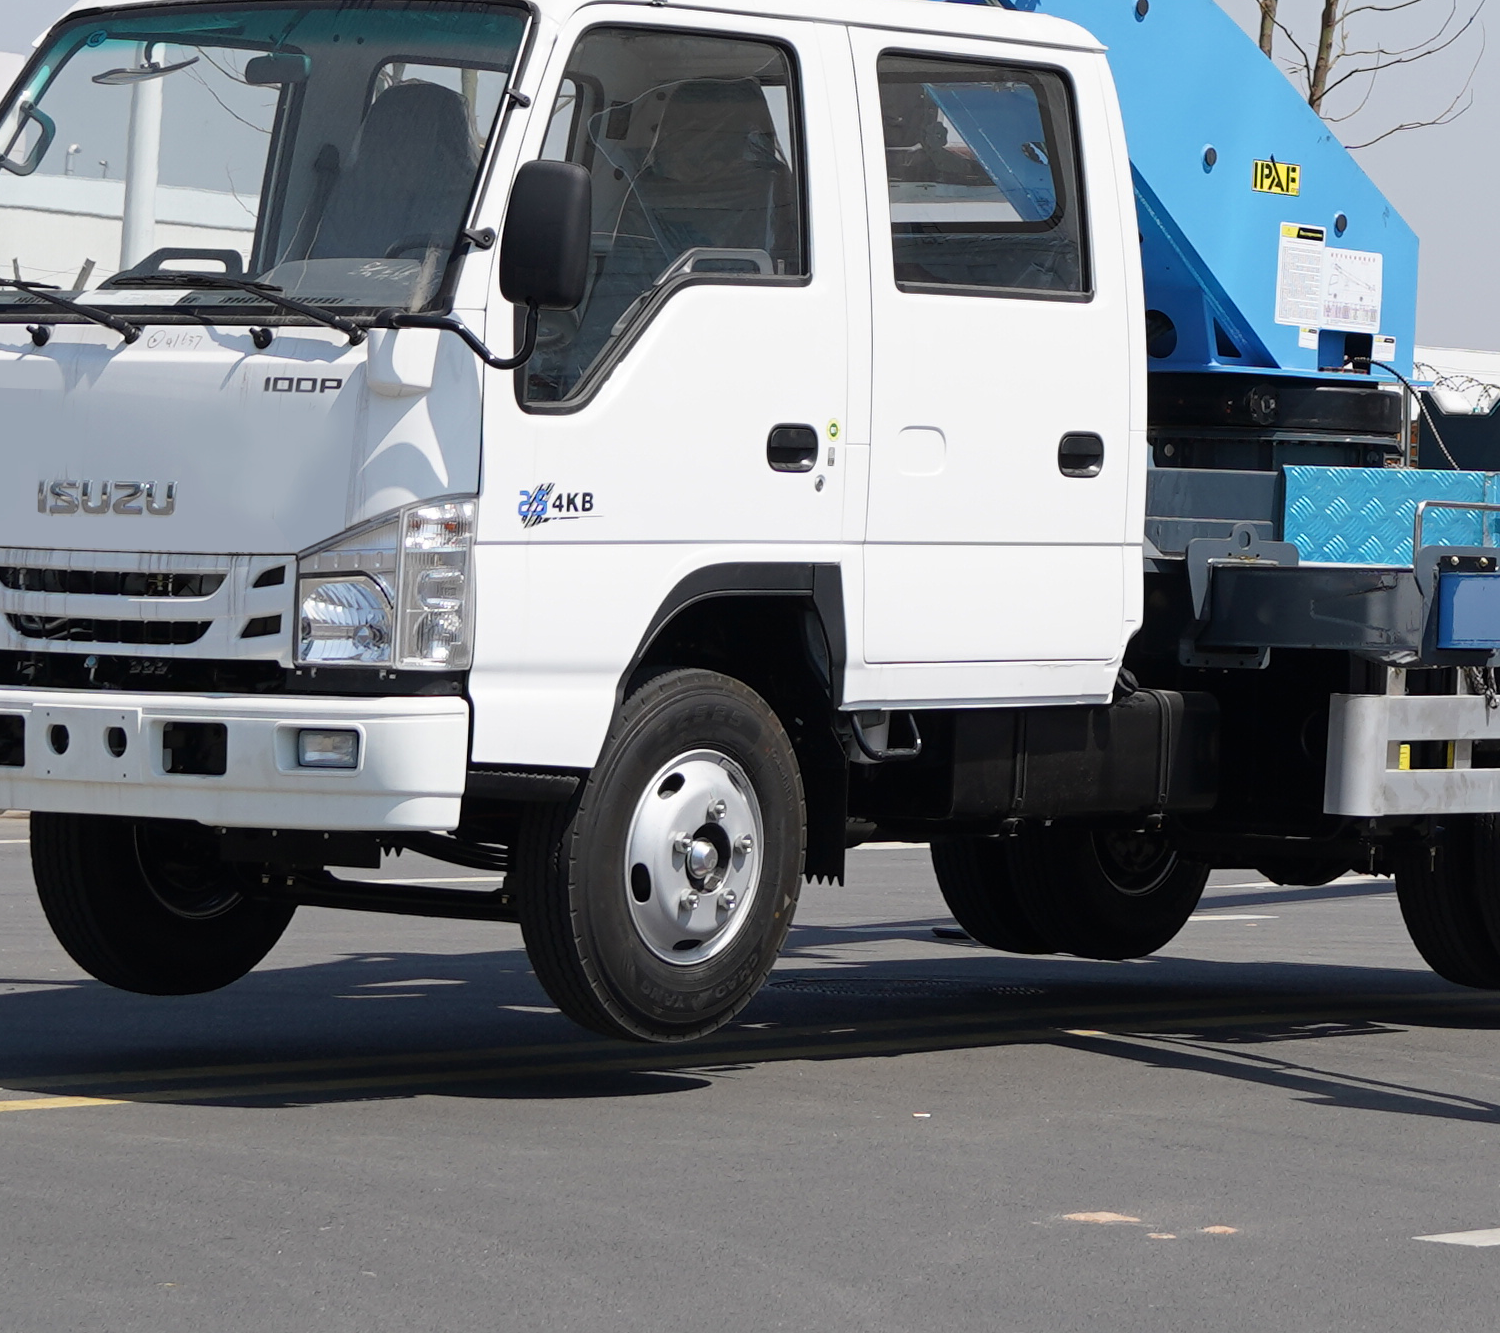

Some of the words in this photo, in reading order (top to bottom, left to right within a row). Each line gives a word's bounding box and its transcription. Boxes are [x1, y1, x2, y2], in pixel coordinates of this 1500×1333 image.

[1253, 153, 1297, 193] IPAF
[264, 376, 343, 394] 100P
[37, 478, 179, 518] ISUZU
[552, 492, 594, 512] 4KB
